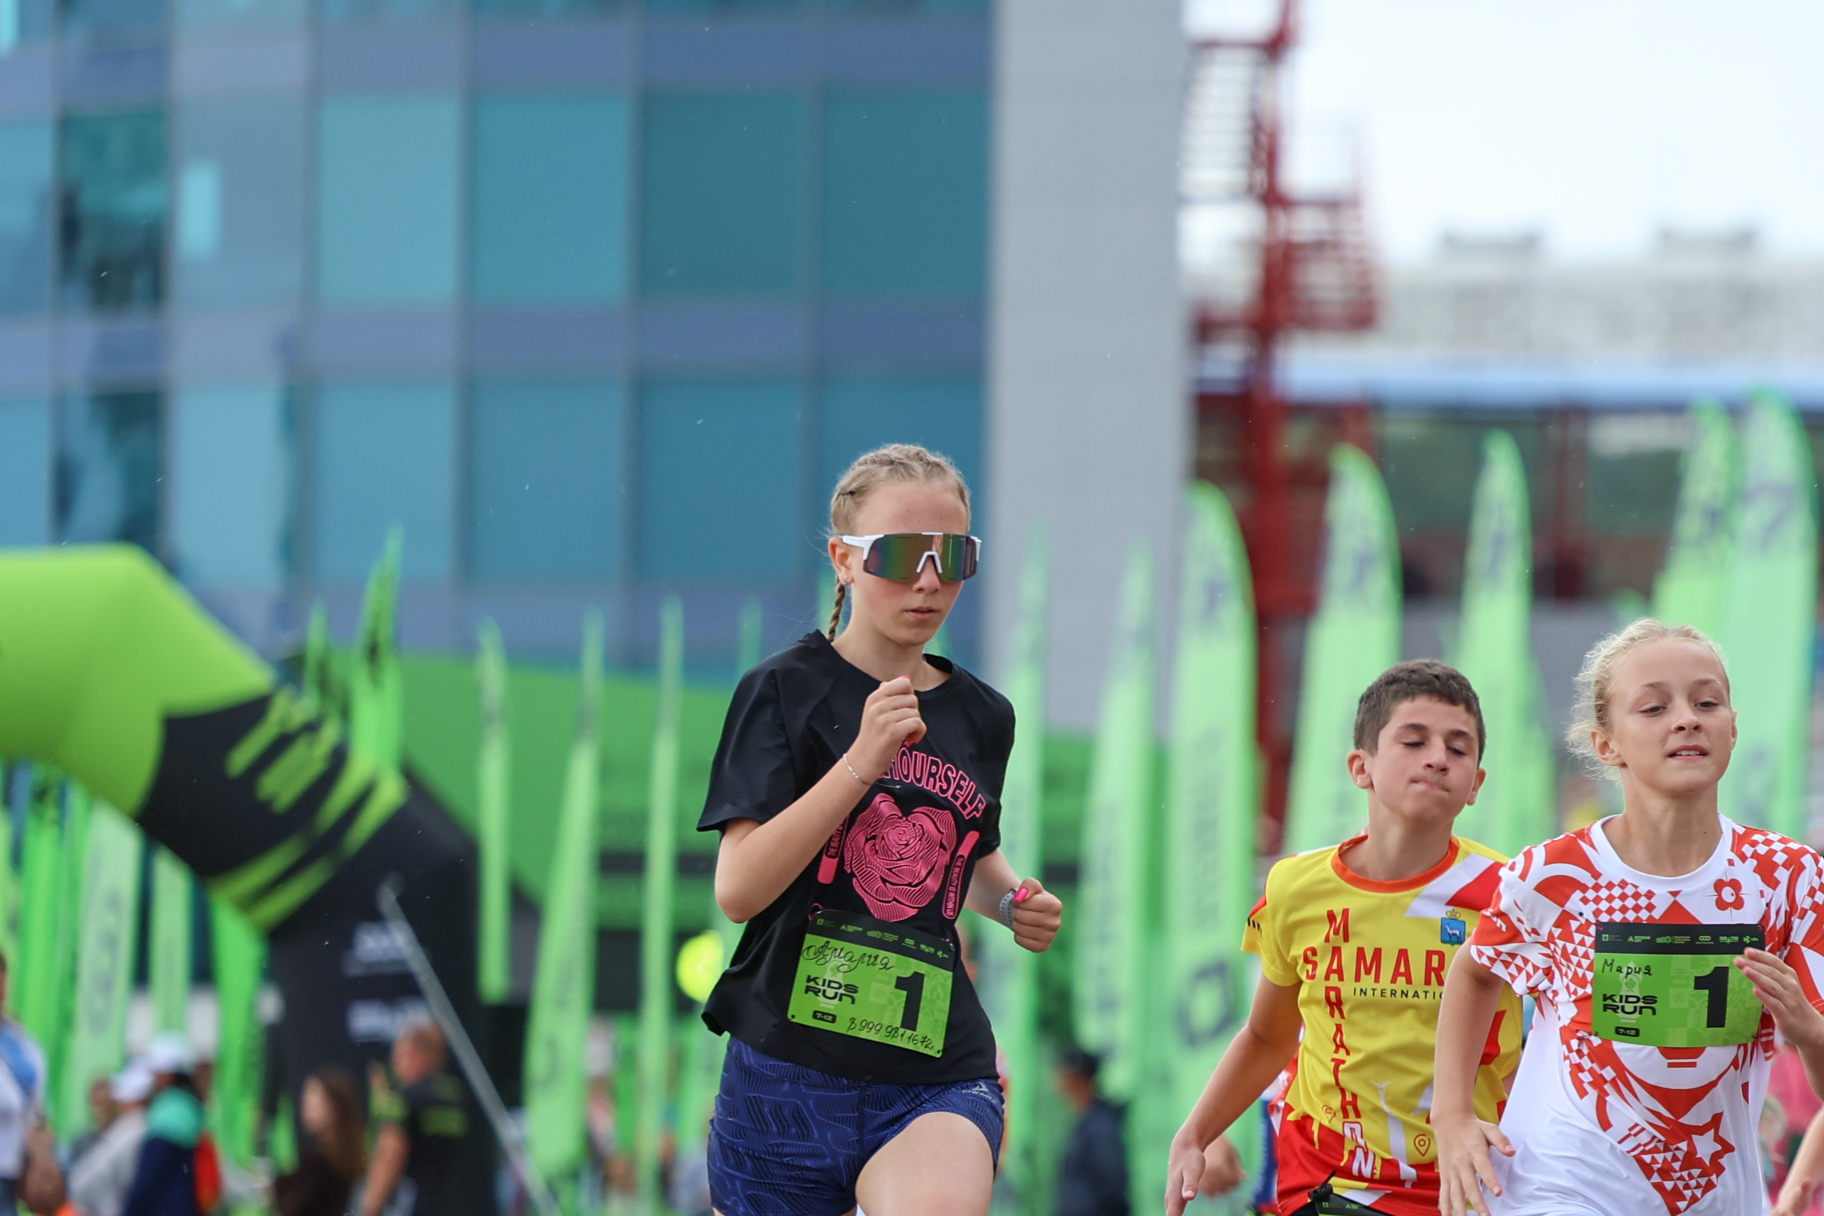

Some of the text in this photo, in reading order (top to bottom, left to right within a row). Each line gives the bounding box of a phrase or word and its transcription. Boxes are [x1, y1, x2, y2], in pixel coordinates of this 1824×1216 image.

[1303, 946, 1446, 987] SAMAR
[1602, 958, 1653, 979] Мария
[806, 975, 859, 994] KIDS
[894, 971, 926, 1032] 1
[1602, 994, 1658, 1004] KIDS
[1694, 966, 1730, 1028] 1
[846, 1017, 857, 1033] 8
[858, 1019, 883, 1035] 999
[885, 1025, 907, 1041] 981
[907, 1032, 919, 1045] 16
[1324, 908, 1377, 1180] MARATHON
